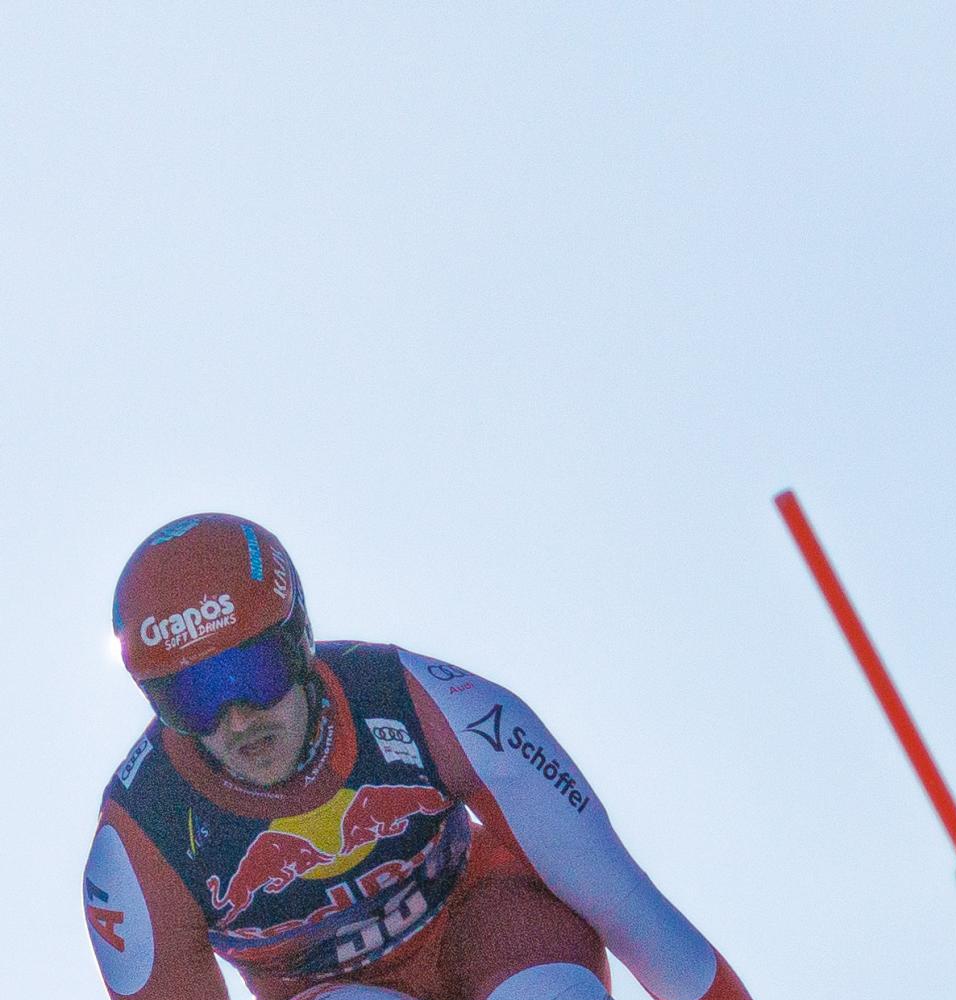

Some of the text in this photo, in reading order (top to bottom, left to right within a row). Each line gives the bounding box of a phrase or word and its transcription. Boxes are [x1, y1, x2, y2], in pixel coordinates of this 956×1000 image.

[165, 614, 237, 651] SOFT DRINKS
[450, 681, 474, 694] Audi
[507, 725, 590, 815] Schöffel
[86, 877, 124, 953] A1
